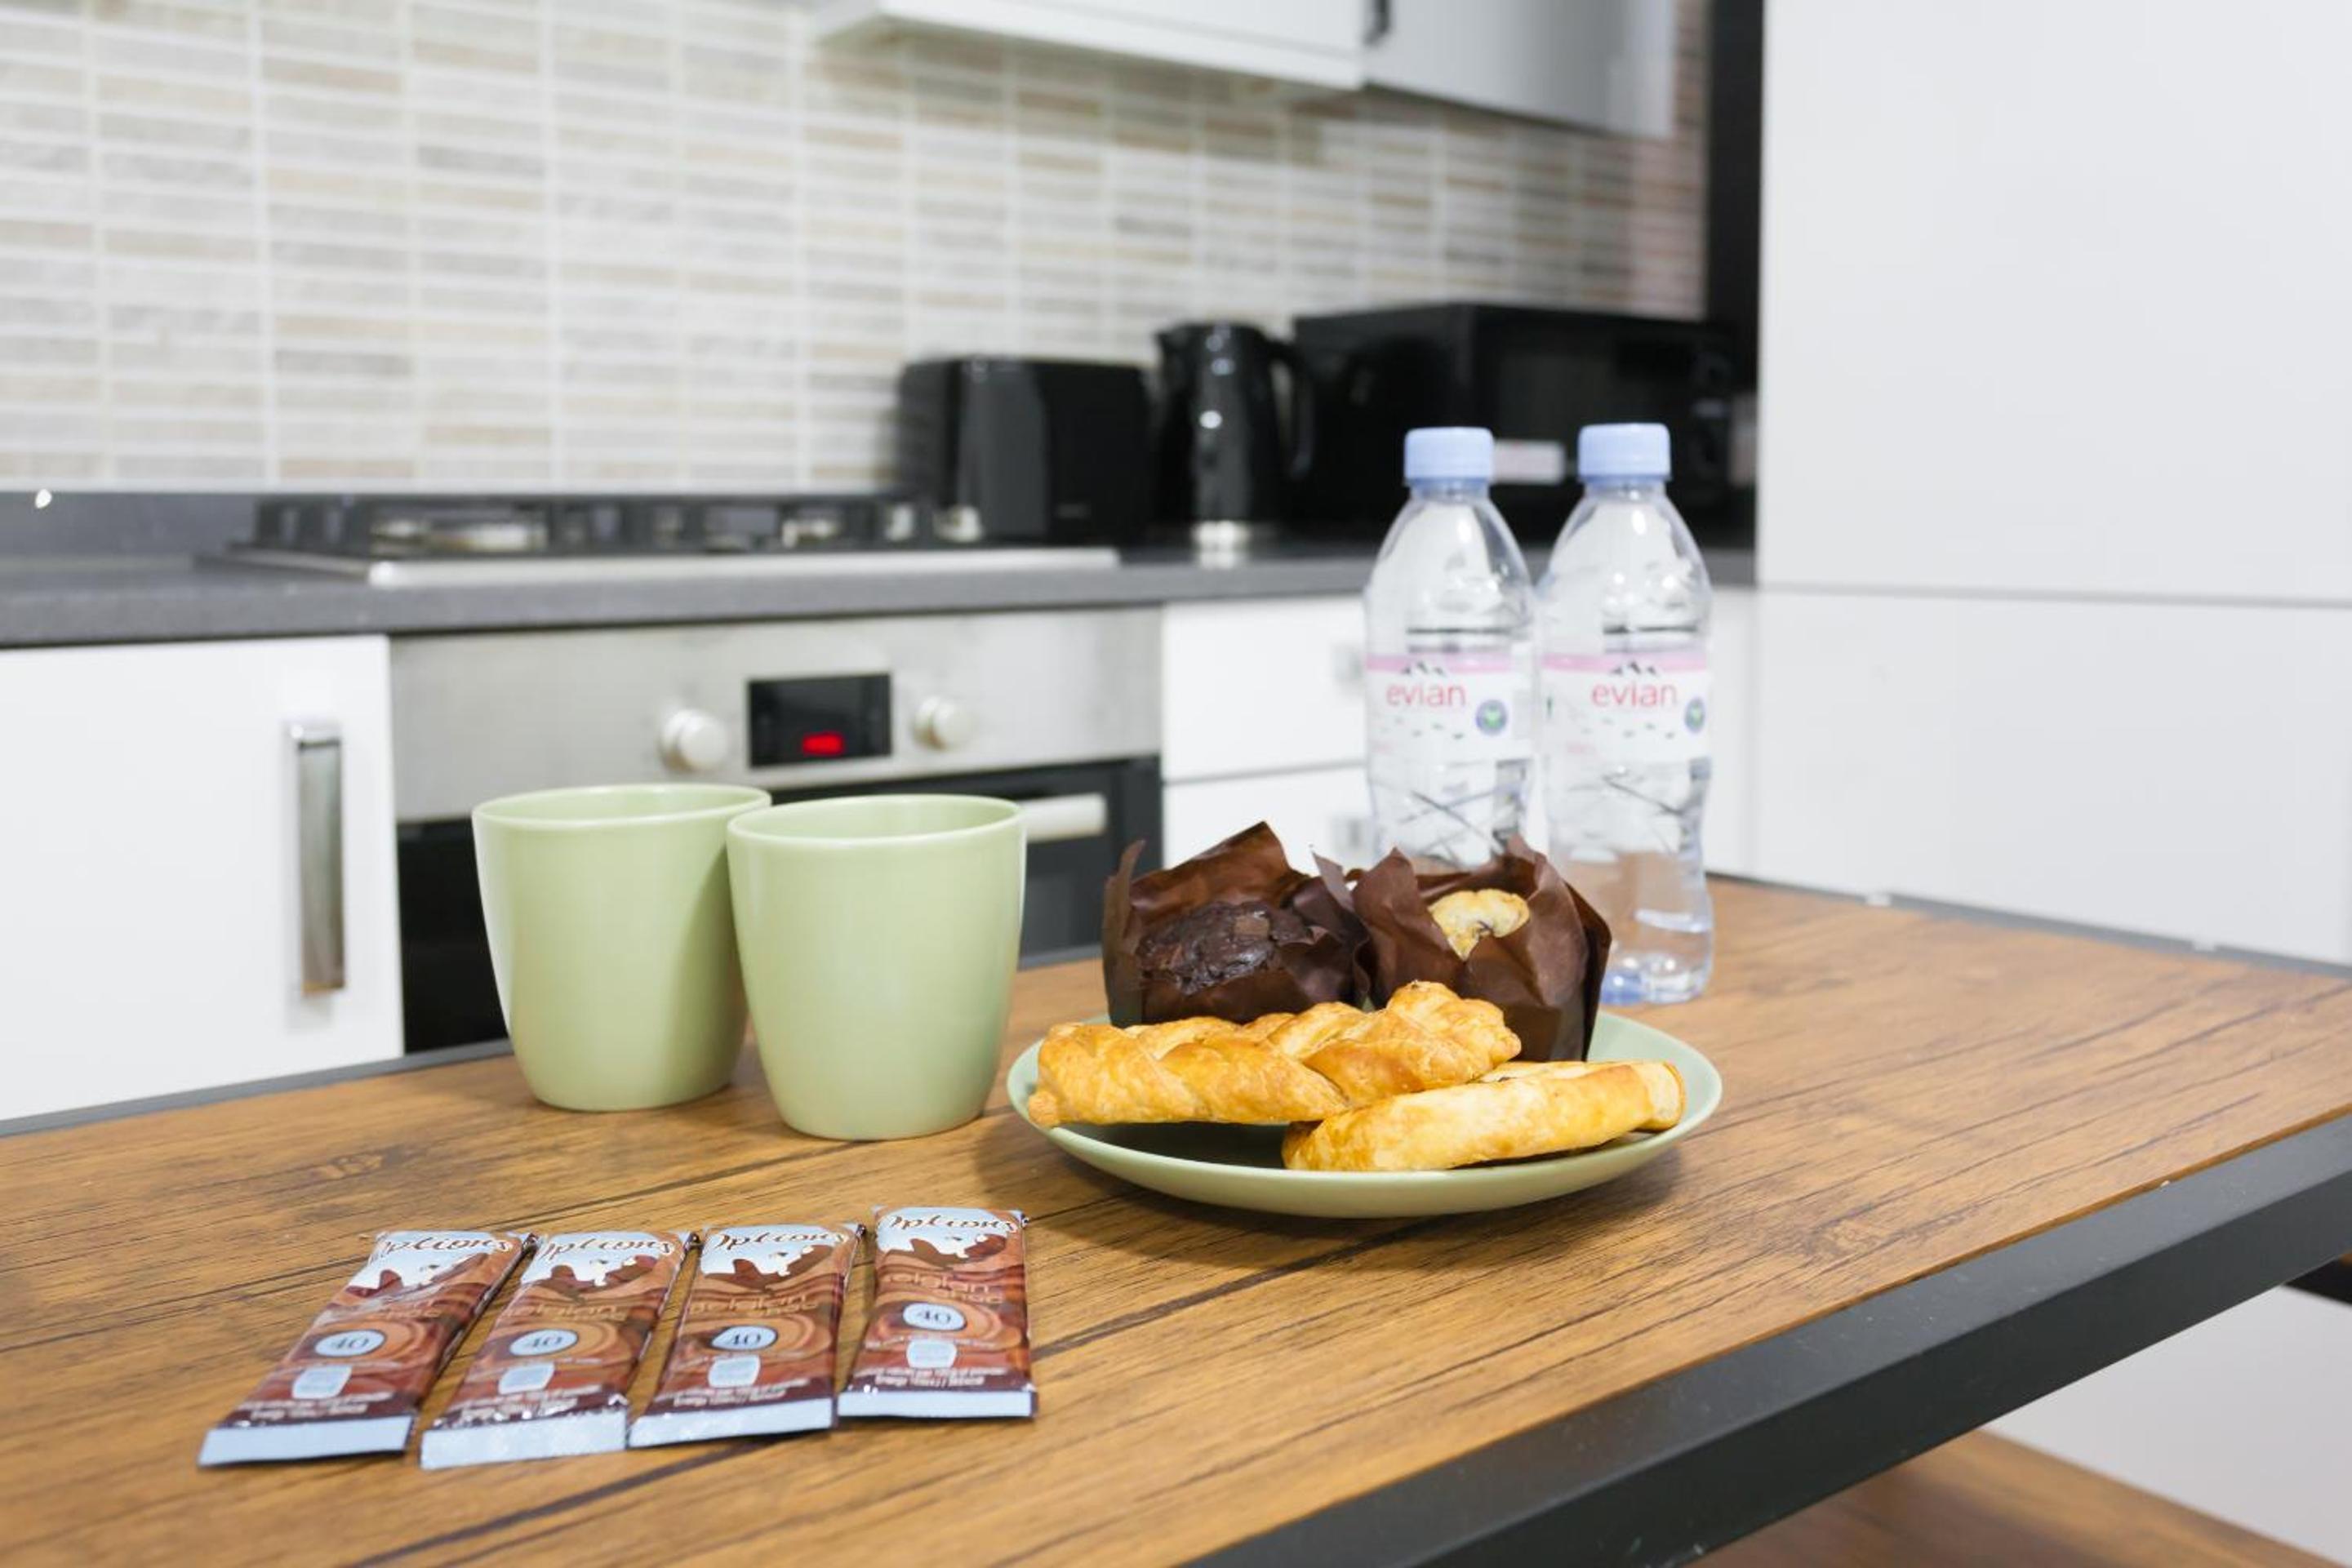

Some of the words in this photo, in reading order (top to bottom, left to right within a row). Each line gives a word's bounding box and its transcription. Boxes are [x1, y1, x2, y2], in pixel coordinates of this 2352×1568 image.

[1385, 682, 1467, 707] evian
[1591, 682, 1678, 707] evian
[378, 1235, 511, 1257] ptions
[916, 1309, 952, 1323] 40
[331, 1337, 371, 1349] 40
[528, 1335, 563, 1348] 40
[727, 1332, 763, 1345] 40
